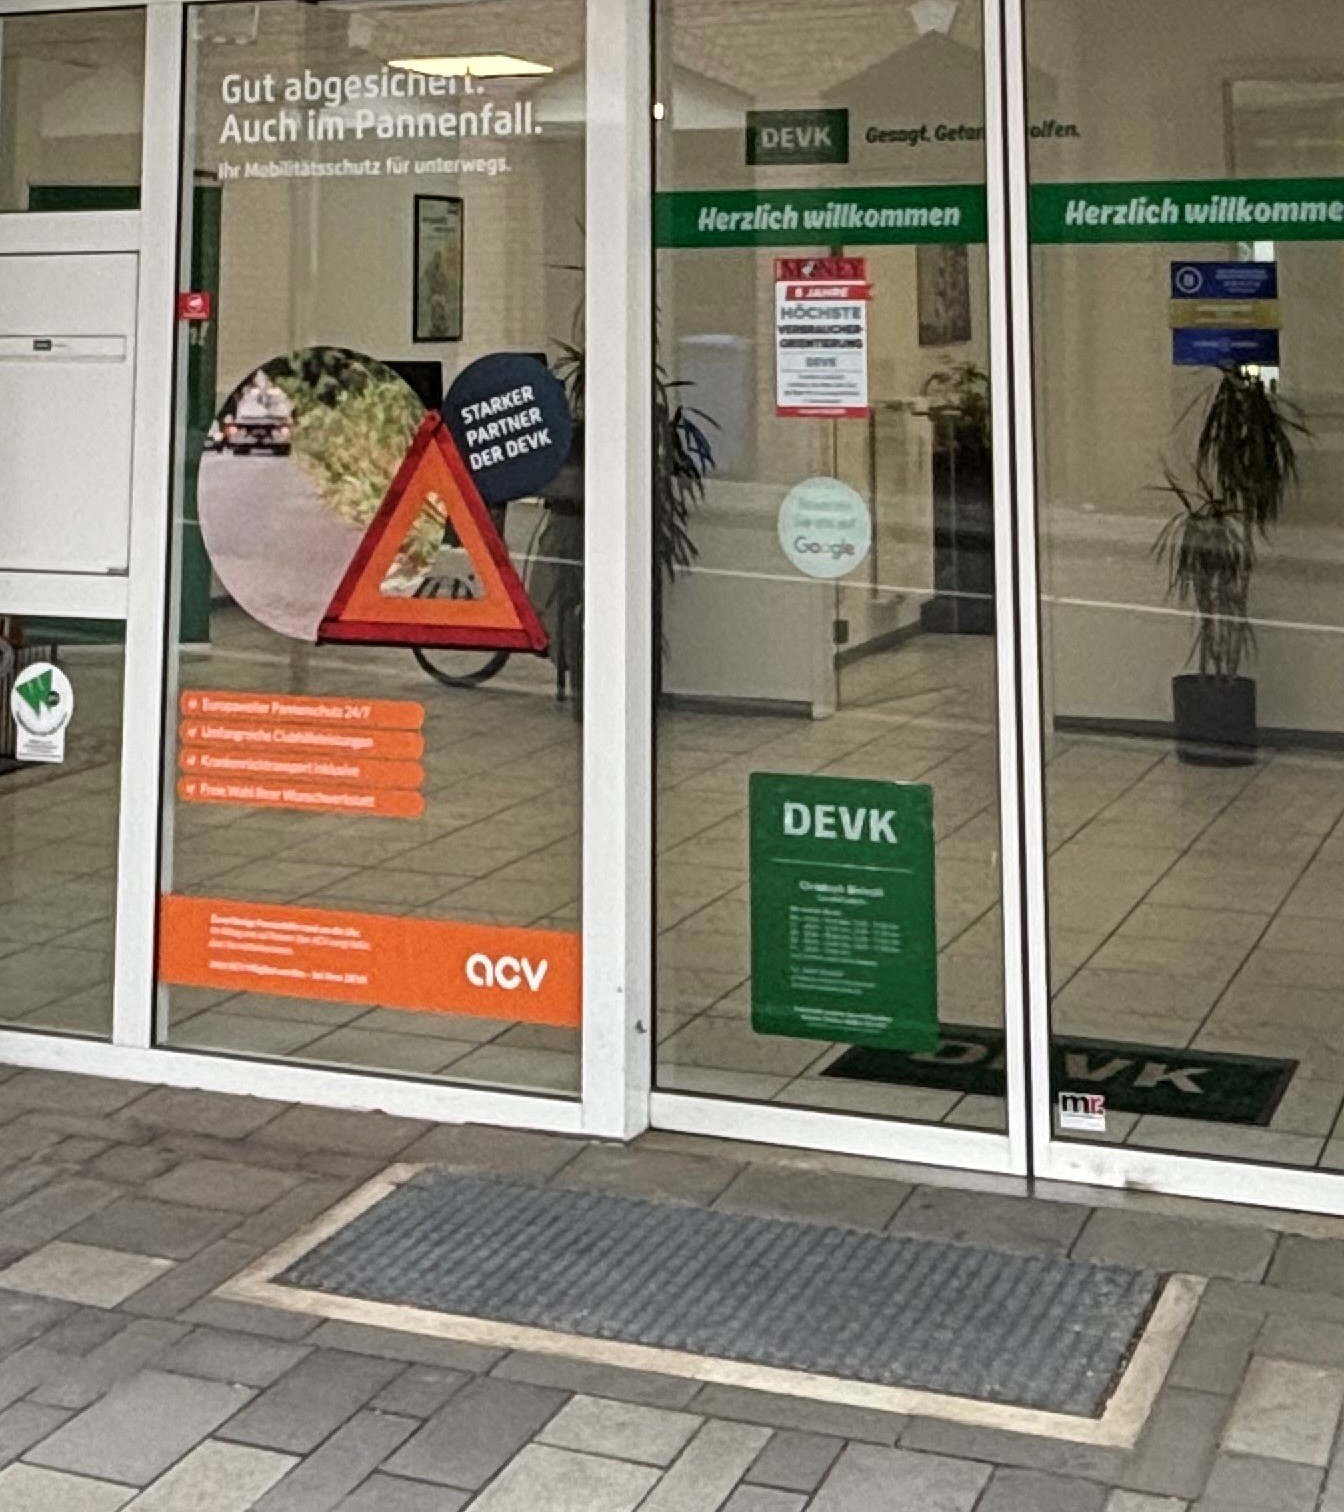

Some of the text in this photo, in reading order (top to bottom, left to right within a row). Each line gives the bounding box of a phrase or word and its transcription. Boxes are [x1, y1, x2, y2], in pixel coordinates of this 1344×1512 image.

[221, 67, 485, 107] Gut abgesichert.
[219, 101, 543, 144] Auch im Pannenfall.
[761, 125, 833, 149] DEVK
[865, 124, 931, 147] Gesagt.
[934, 123, 984, 142] Geta
[218, 156, 512, 180] Ihr Mobilitätsschutz für unterwegs.
[698, 201, 962, 232] Herzlich willkommen
[1065, 196, 1178, 226] Herzlich
[780, 303, 862, 320] HÖCHSTE
[461, 385, 536, 426] STARKER
[466, 406, 544, 448] PARTNER
[469, 427, 554, 471] DER DEVK
[793, 535, 855, 560] Google
[782, 801, 898, 844] DEVK
[466, 952, 549, 992] acv
[909, 1039, 1210, 1095] DVK
